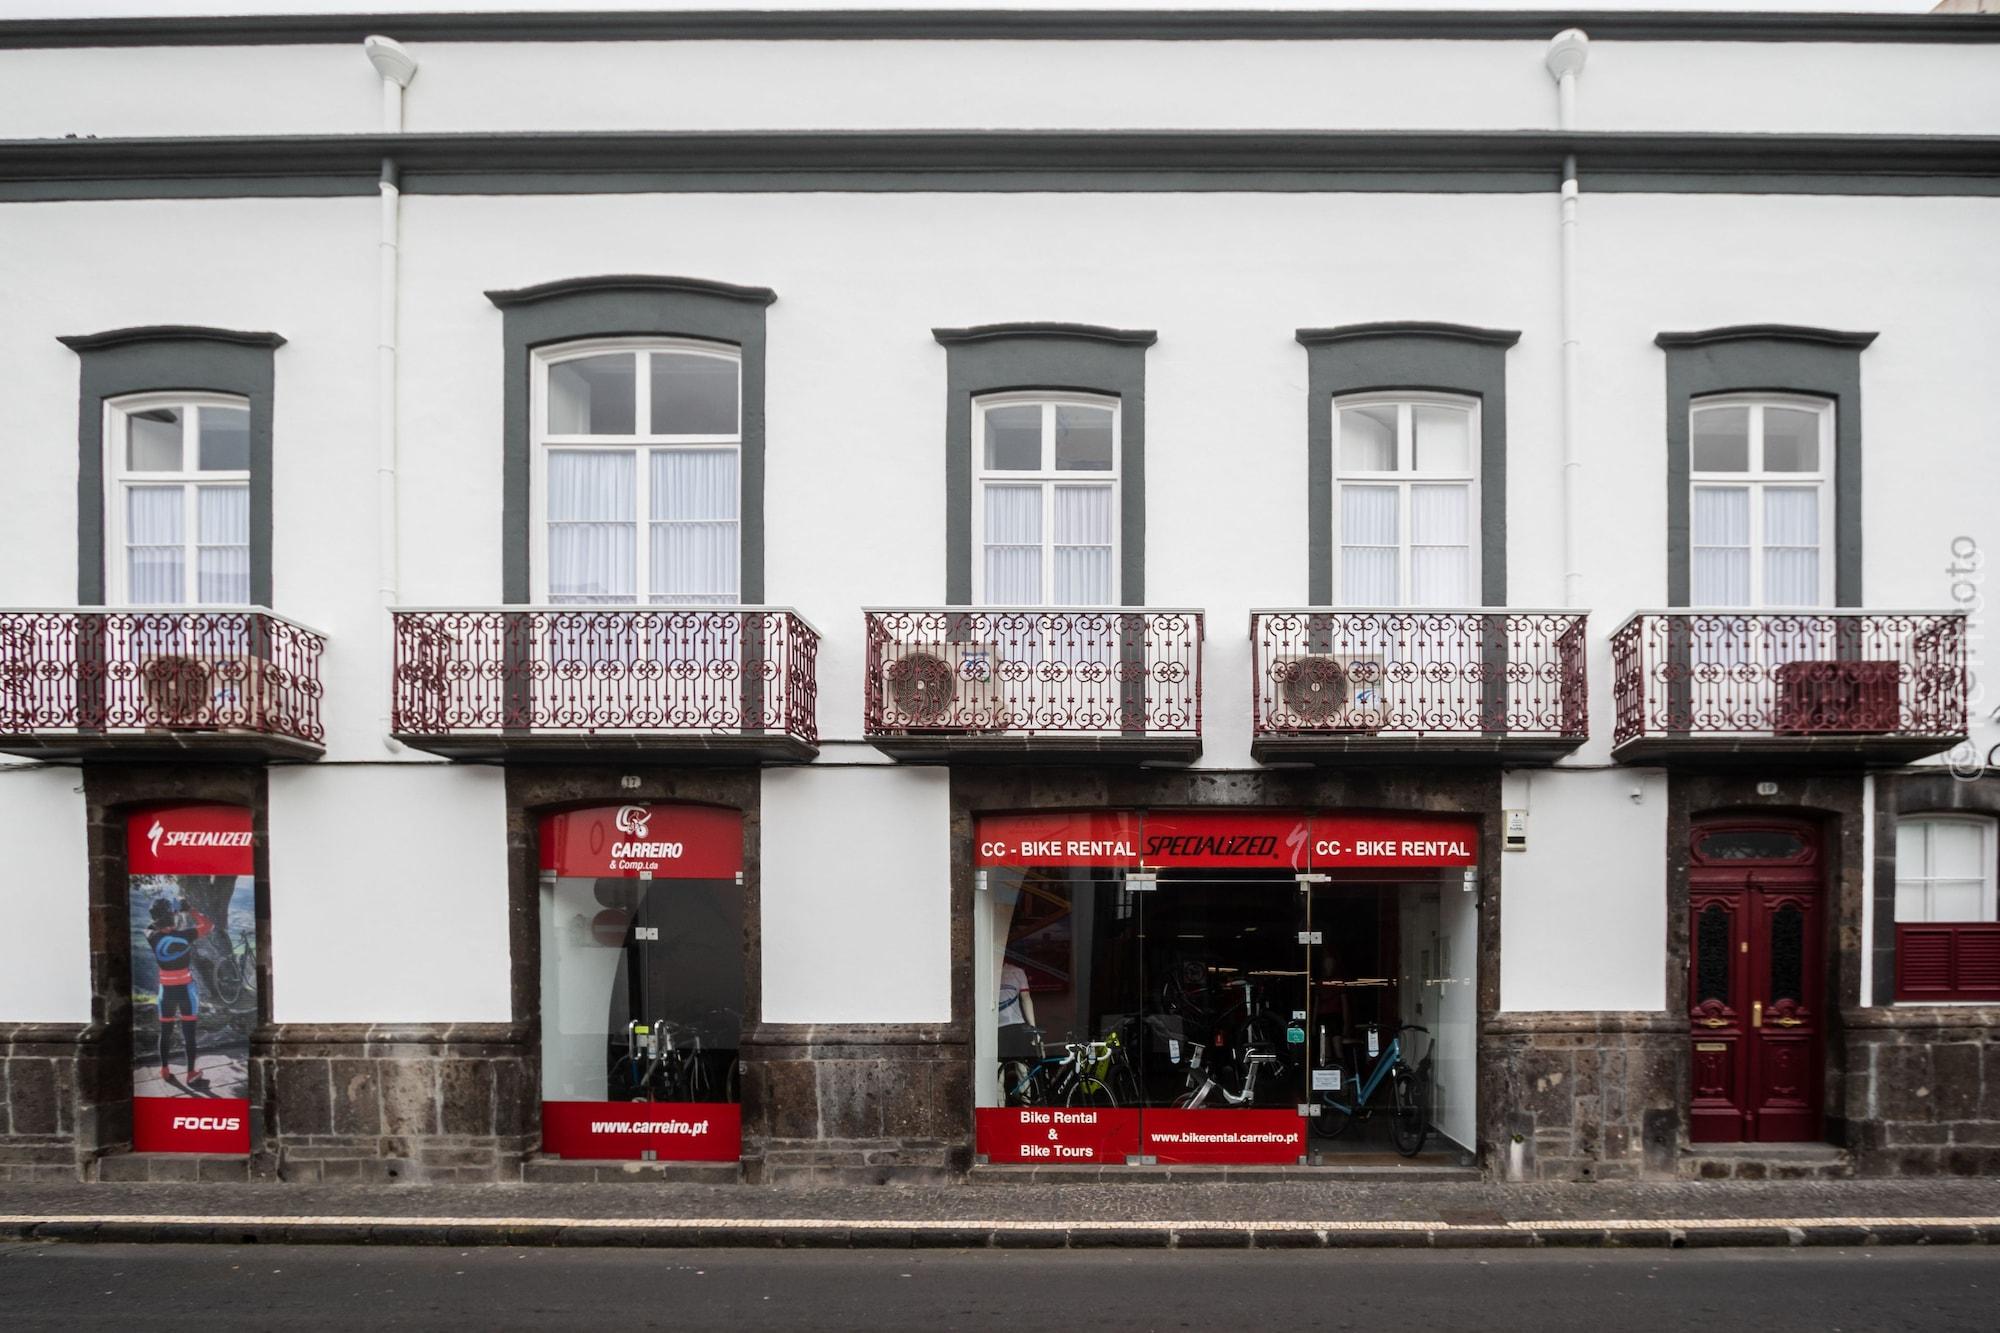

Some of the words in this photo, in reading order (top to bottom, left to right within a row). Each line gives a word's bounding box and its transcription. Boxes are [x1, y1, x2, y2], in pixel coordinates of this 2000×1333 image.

[163, 831, 253, 846] SPECIALIZED
[1142, 835, 1277, 856] SPECIALIZED
[611, 842, 683, 859] CARREIRO
[981, 842, 1006, 857] CC
[1021, 841, 1062, 856] BIKE
[1067, 841, 1136, 856] RENTAL
[1315, 841, 1340, 856] CC
[1356, 841, 1396, 856] BIKE
[1402, 842, 1470, 857] RENTAL
[609, 860, 617, 870] &
[173, 1117, 240, 1131] FOCUS
[1020, 1111, 1050, 1124] Bike
[1054, 1112, 1097, 1124] Rental
[591, 1119, 709, 1136] www.carreiro.pt
[1048, 1128, 1058, 1140] &
[1151, 1132, 1298, 1144] www.bikerental.carreiro.pt
[1020, 1145, 1050, 1157] Bike
[1053, 1145, 1093, 1157] Tours
